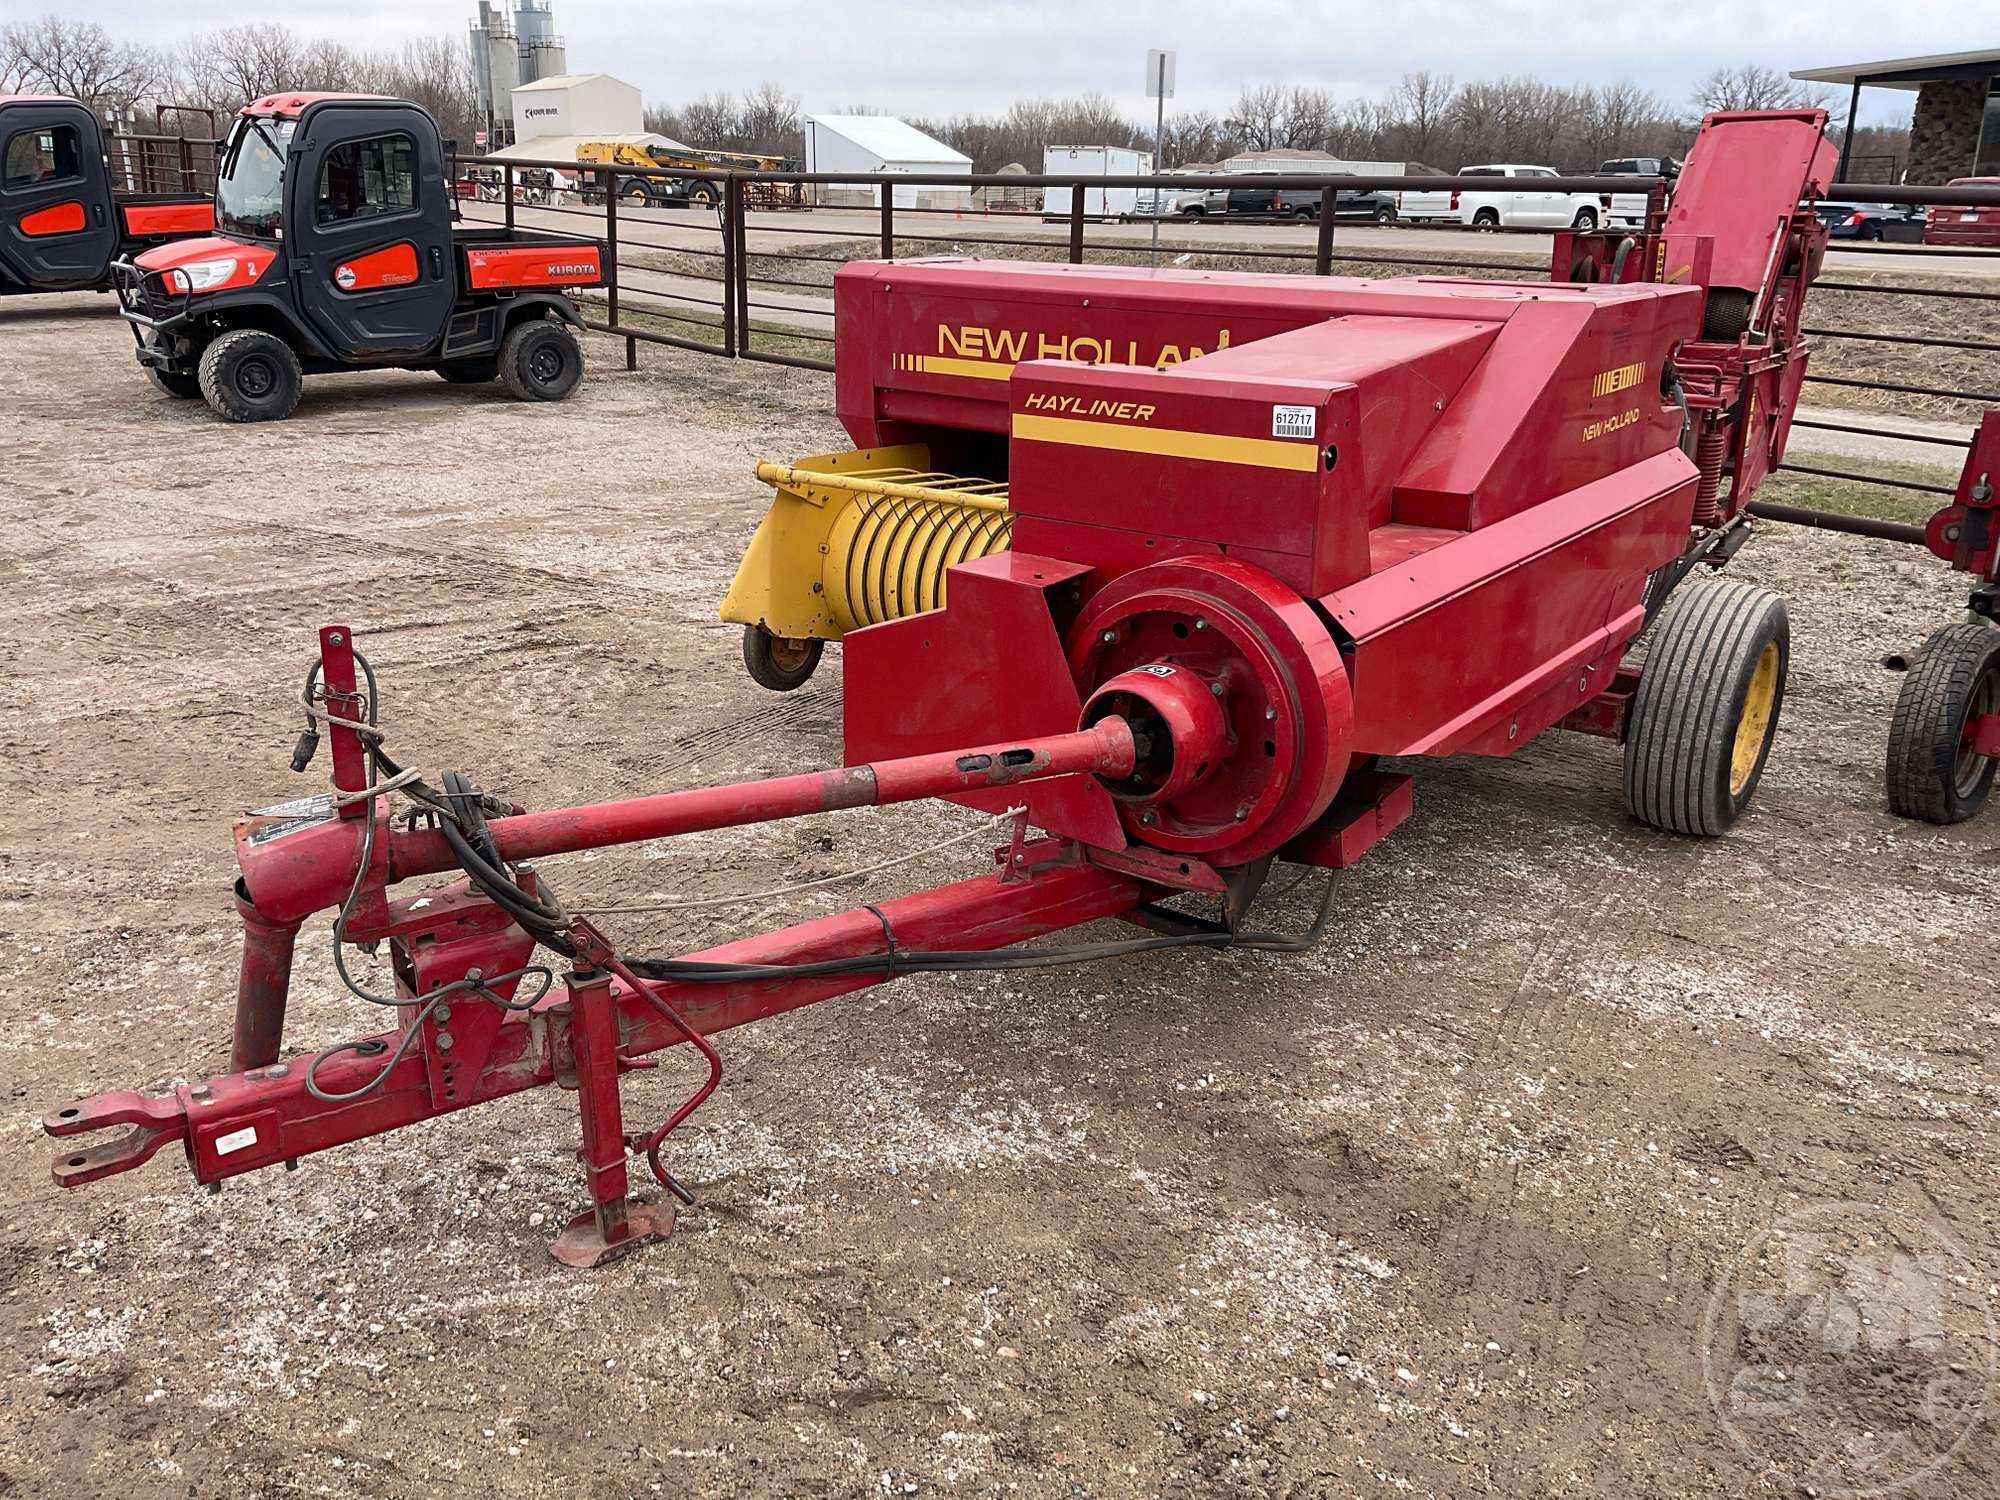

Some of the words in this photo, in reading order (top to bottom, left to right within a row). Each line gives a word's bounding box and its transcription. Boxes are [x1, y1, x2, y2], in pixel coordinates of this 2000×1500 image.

[247, 262, 257, 276] 2
[547, 264, 597, 277] KUBOTA
[938, 324, 1028, 361] NEW
[1025, 393, 1156, 421] HAYLINER
[1276, 412, 1312, 425] 612717
[1582, 421, 1603, 442] NEW
[1603, 408, 1640, 434] HOLLAND
